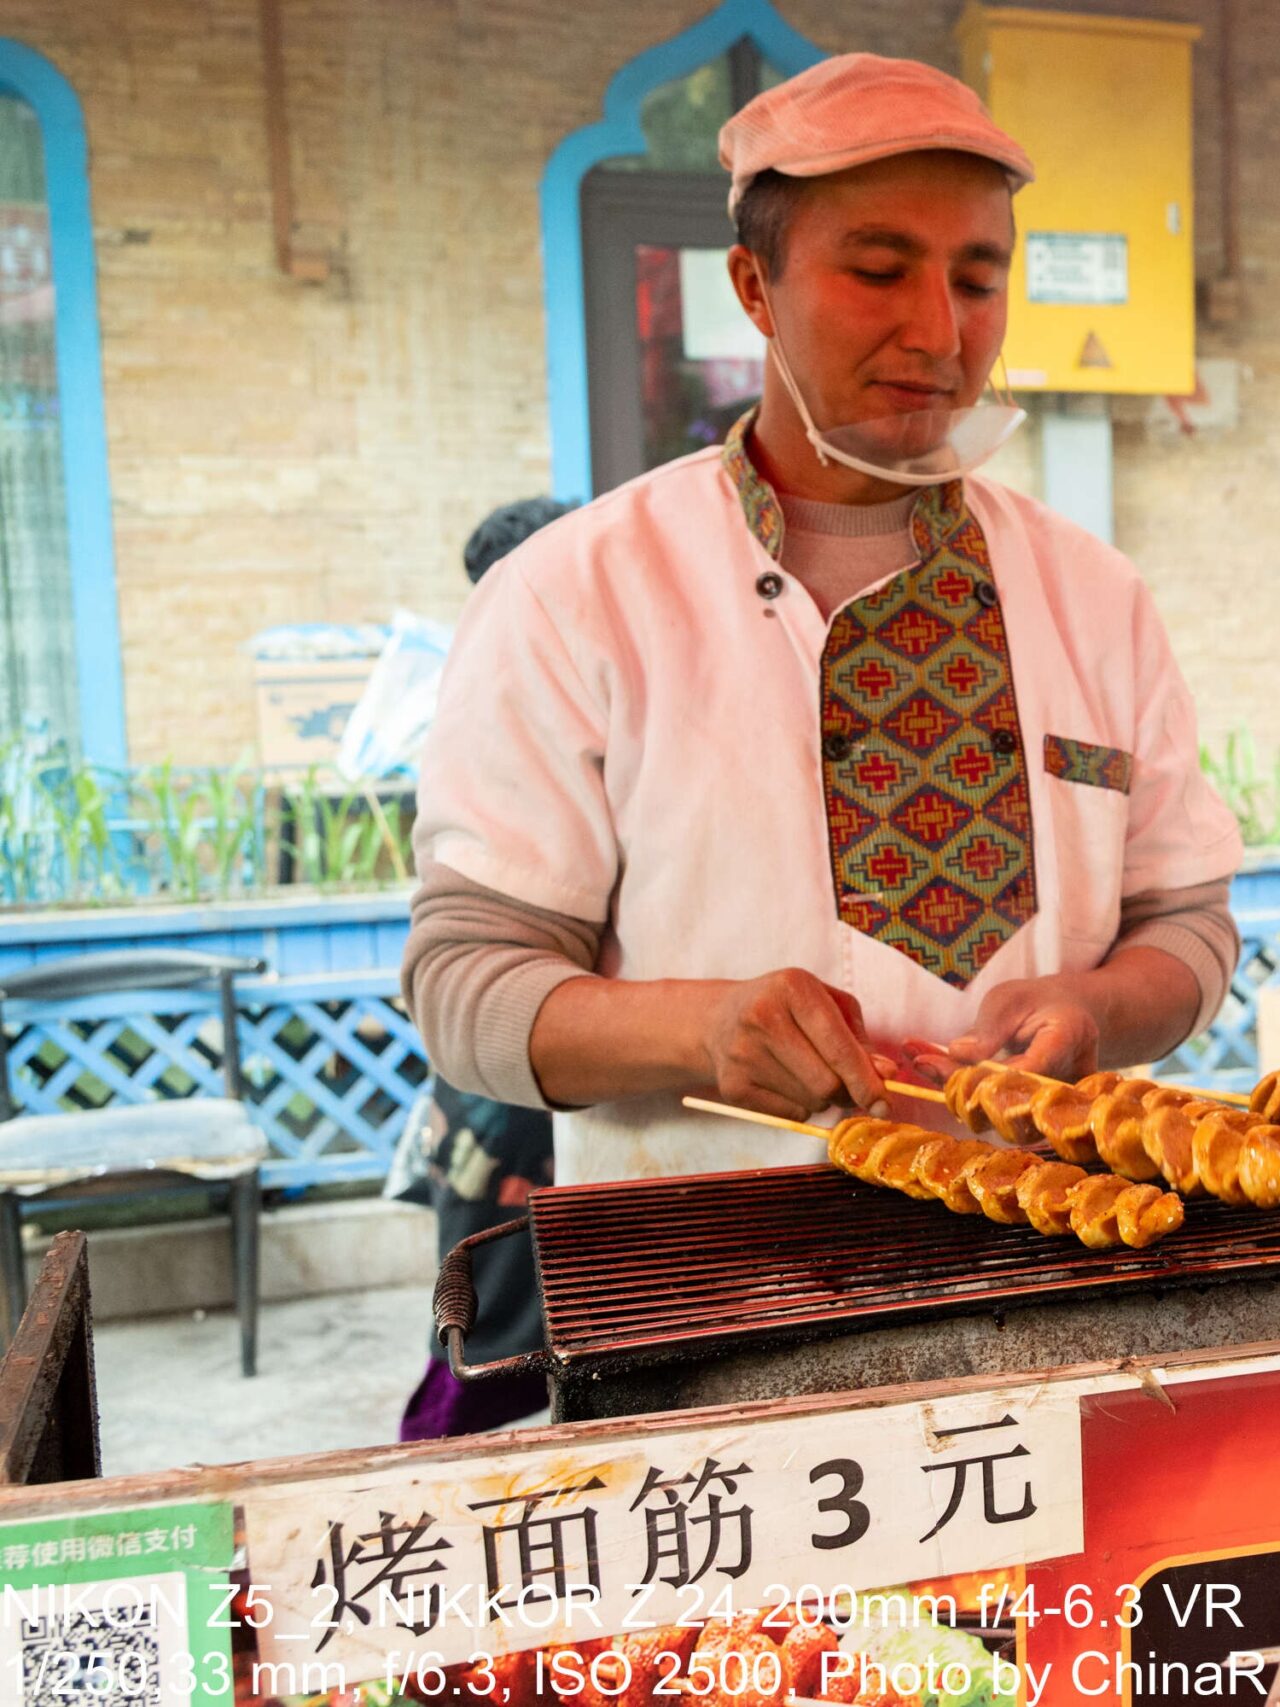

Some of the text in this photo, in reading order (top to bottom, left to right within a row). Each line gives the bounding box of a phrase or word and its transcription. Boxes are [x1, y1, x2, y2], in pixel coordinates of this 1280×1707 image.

[0, 1523, 198, 1570] 荐使用微信支付
[310, 1413, 1037, 1654] 烤面筋 3 元
